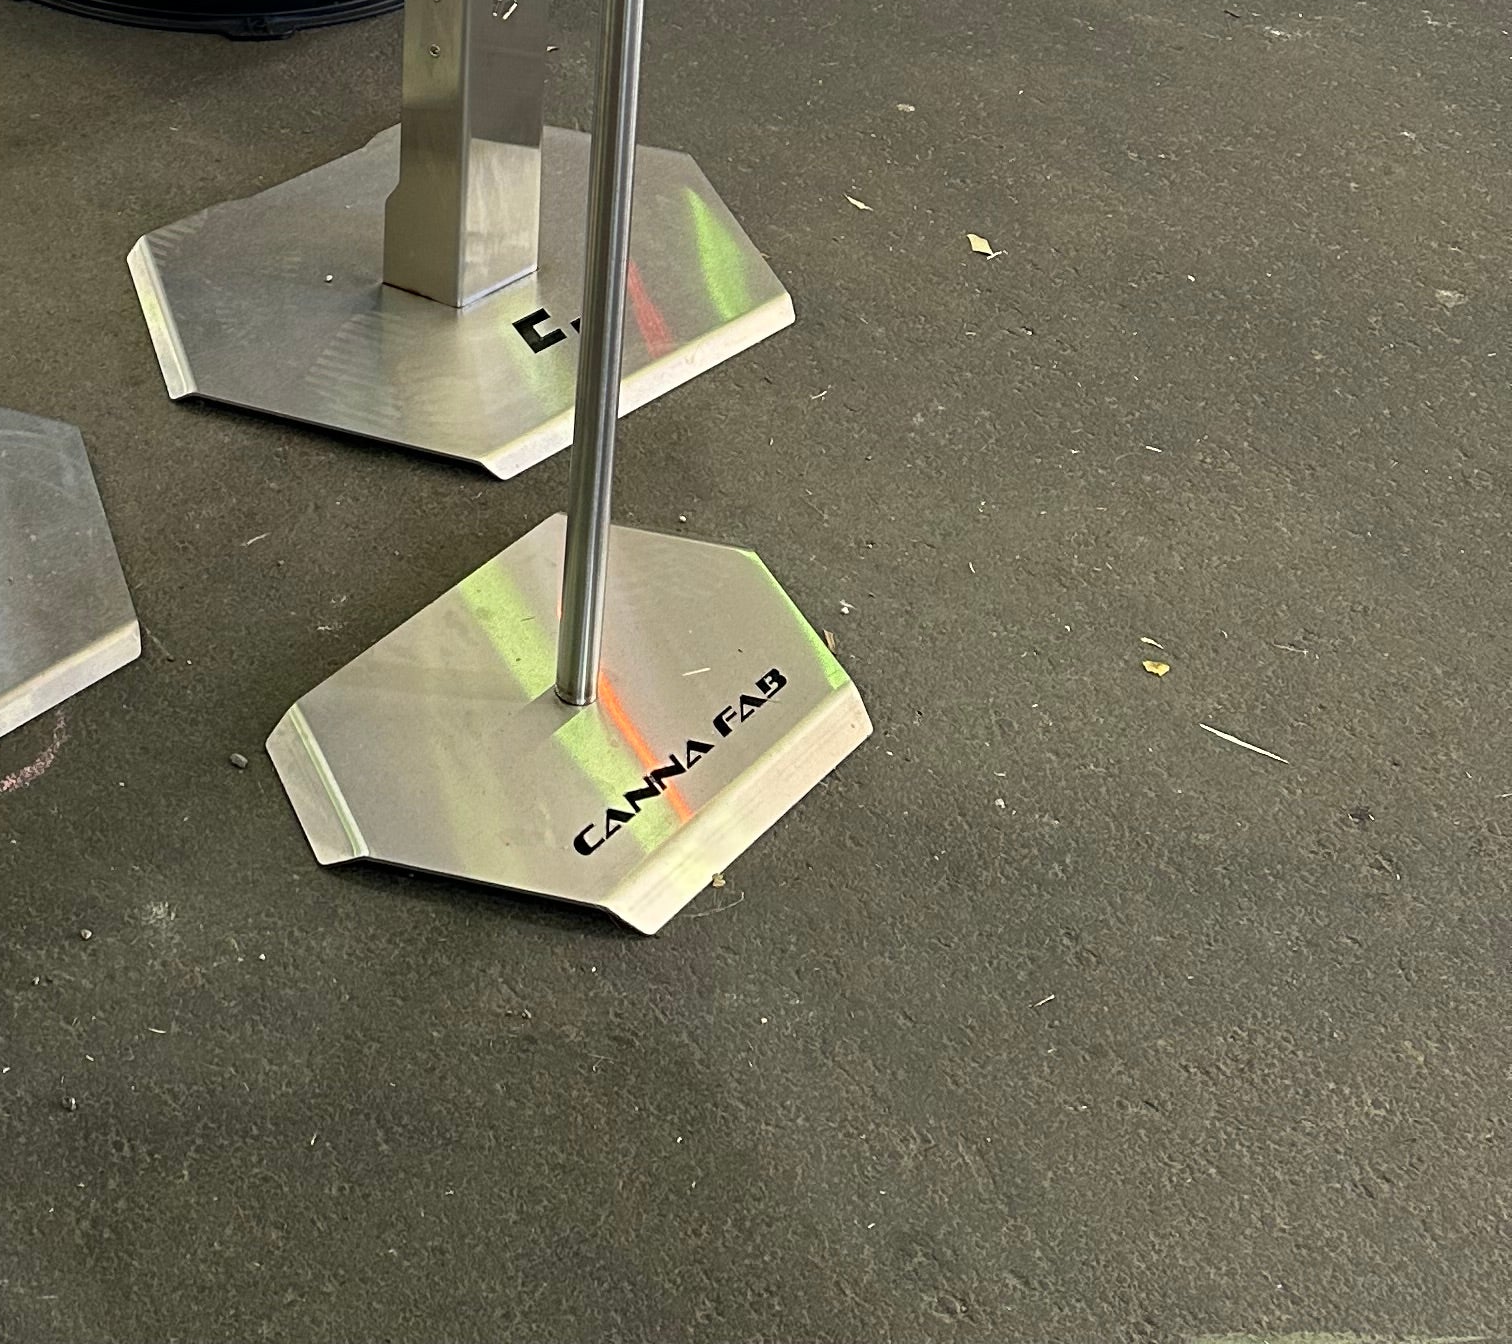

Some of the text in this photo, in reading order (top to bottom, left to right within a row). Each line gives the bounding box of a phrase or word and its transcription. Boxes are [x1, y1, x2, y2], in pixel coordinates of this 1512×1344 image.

[512, 307, 582, 354] C
[573, 668, 788, 856] CANNA FAB
